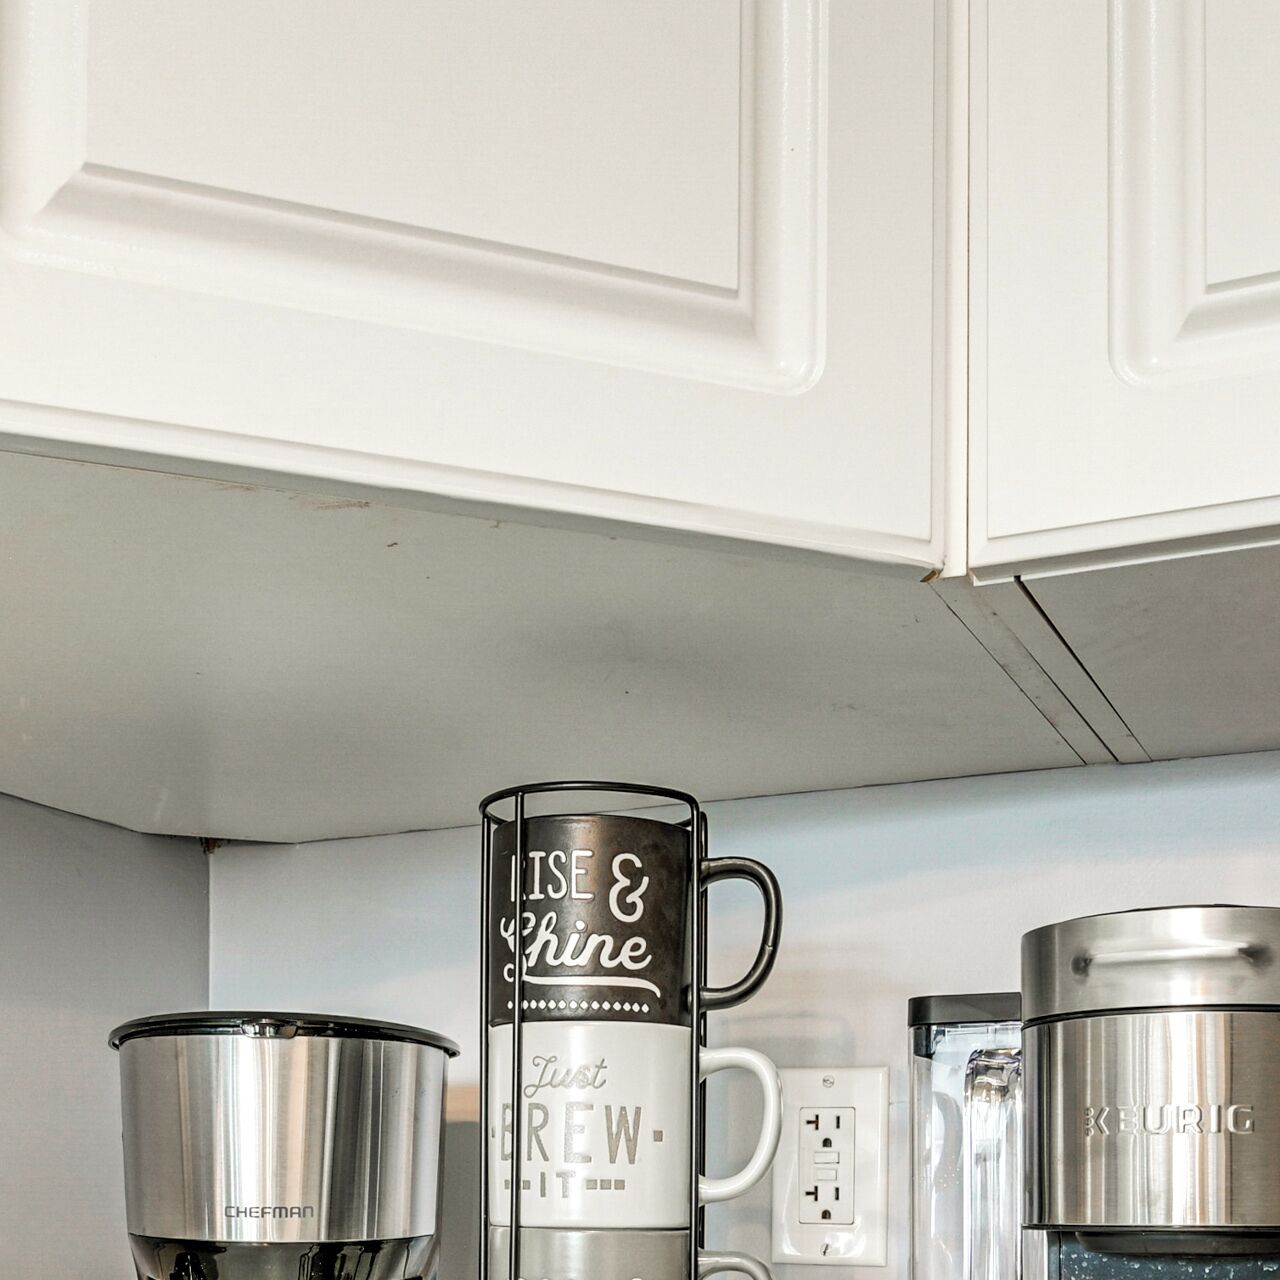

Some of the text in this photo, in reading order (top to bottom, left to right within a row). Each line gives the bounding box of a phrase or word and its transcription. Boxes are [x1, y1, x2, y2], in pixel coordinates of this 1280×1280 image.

[609, 852, 650, 923] &
[499, 911, 656, 984] Shine
[523, 1057, 608, 1098] Just
[1084, 1103, 1255, 1137] KEURIG
[224, 1206, 314, 1218] CHEFMAN
